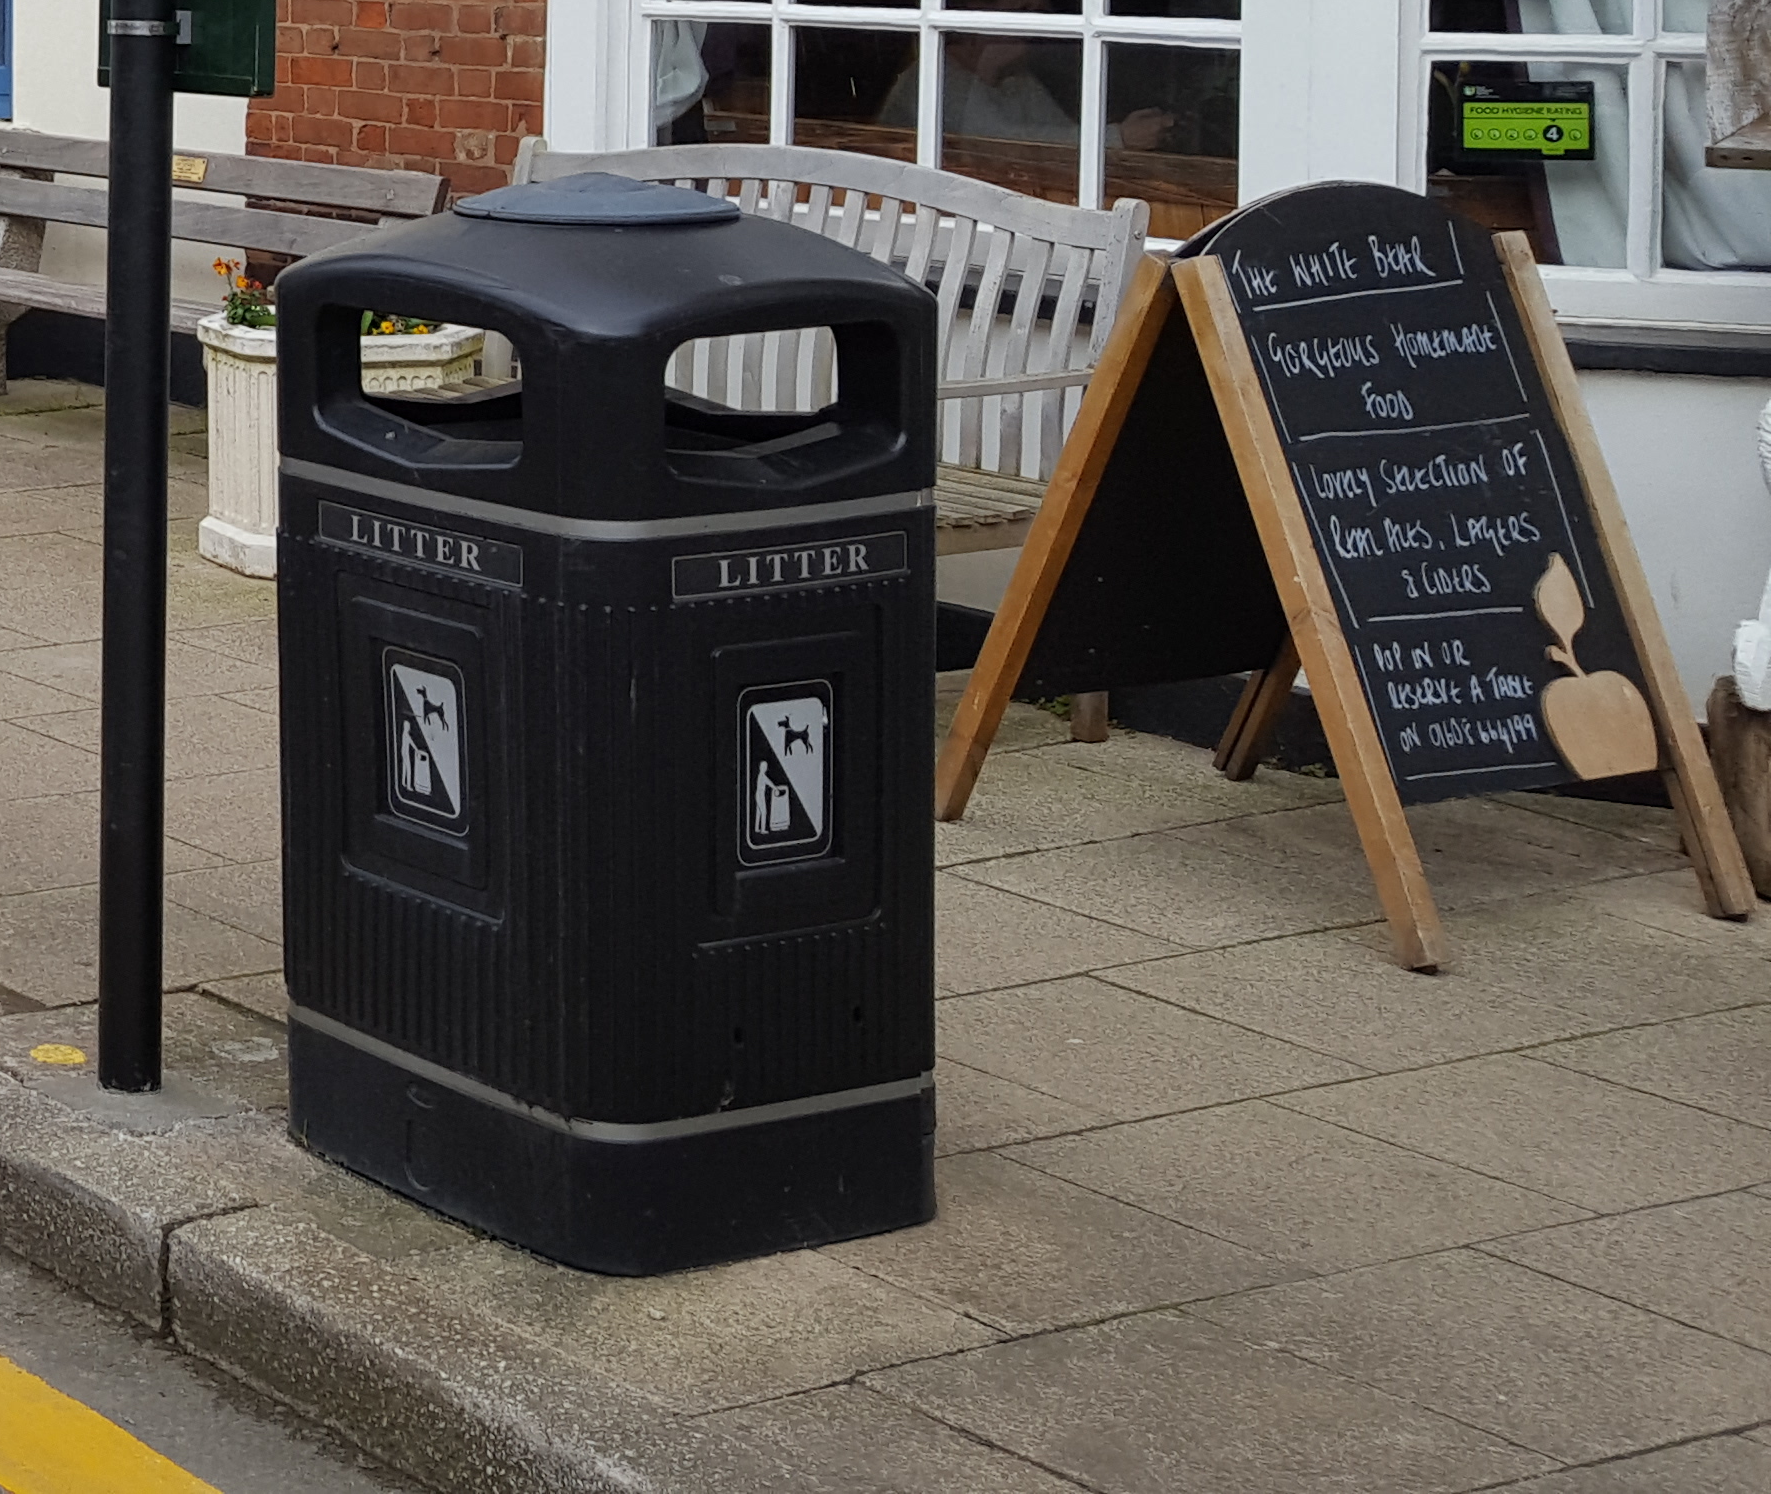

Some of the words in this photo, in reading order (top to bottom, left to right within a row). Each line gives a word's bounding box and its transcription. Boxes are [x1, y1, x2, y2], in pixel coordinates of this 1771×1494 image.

[1470, 107, 1500, 115] FOOD
[1545, 126, 1560, 142] 4
[1232, 249, 1278, 299] THE
[1289, 241, 1358, 288] WHITE
[1368, 235, 1437, 279] BEAR
[1267, 332, 1380, 379] GORGEOUS
[1390, 322, 1498, 369] HOMEMADE
[1361, 381, 1414, 421] FOOD
[1309, 463, 1378, 508] LOVELY
[1379, 453, 1489, 494] SELECTION
[1501, 442, 1528, 477] OF
[350, 512, 483, 572] LITTER
[1449, 510, 1542, 557] LAGERS
[718, 542, 870, 589] LITTER
[1420, 560, 1492, 596] CIDERS
[1373, 640, 1404, 673] POP
[1411, 641, 1434, 670] IN
[1440, 638, 1471, 667] OR
[1387, 676, 1462, 710] RESERVE
[1469, 674, 1486, 705] A
[1399, 721, 1422, 753] ON
